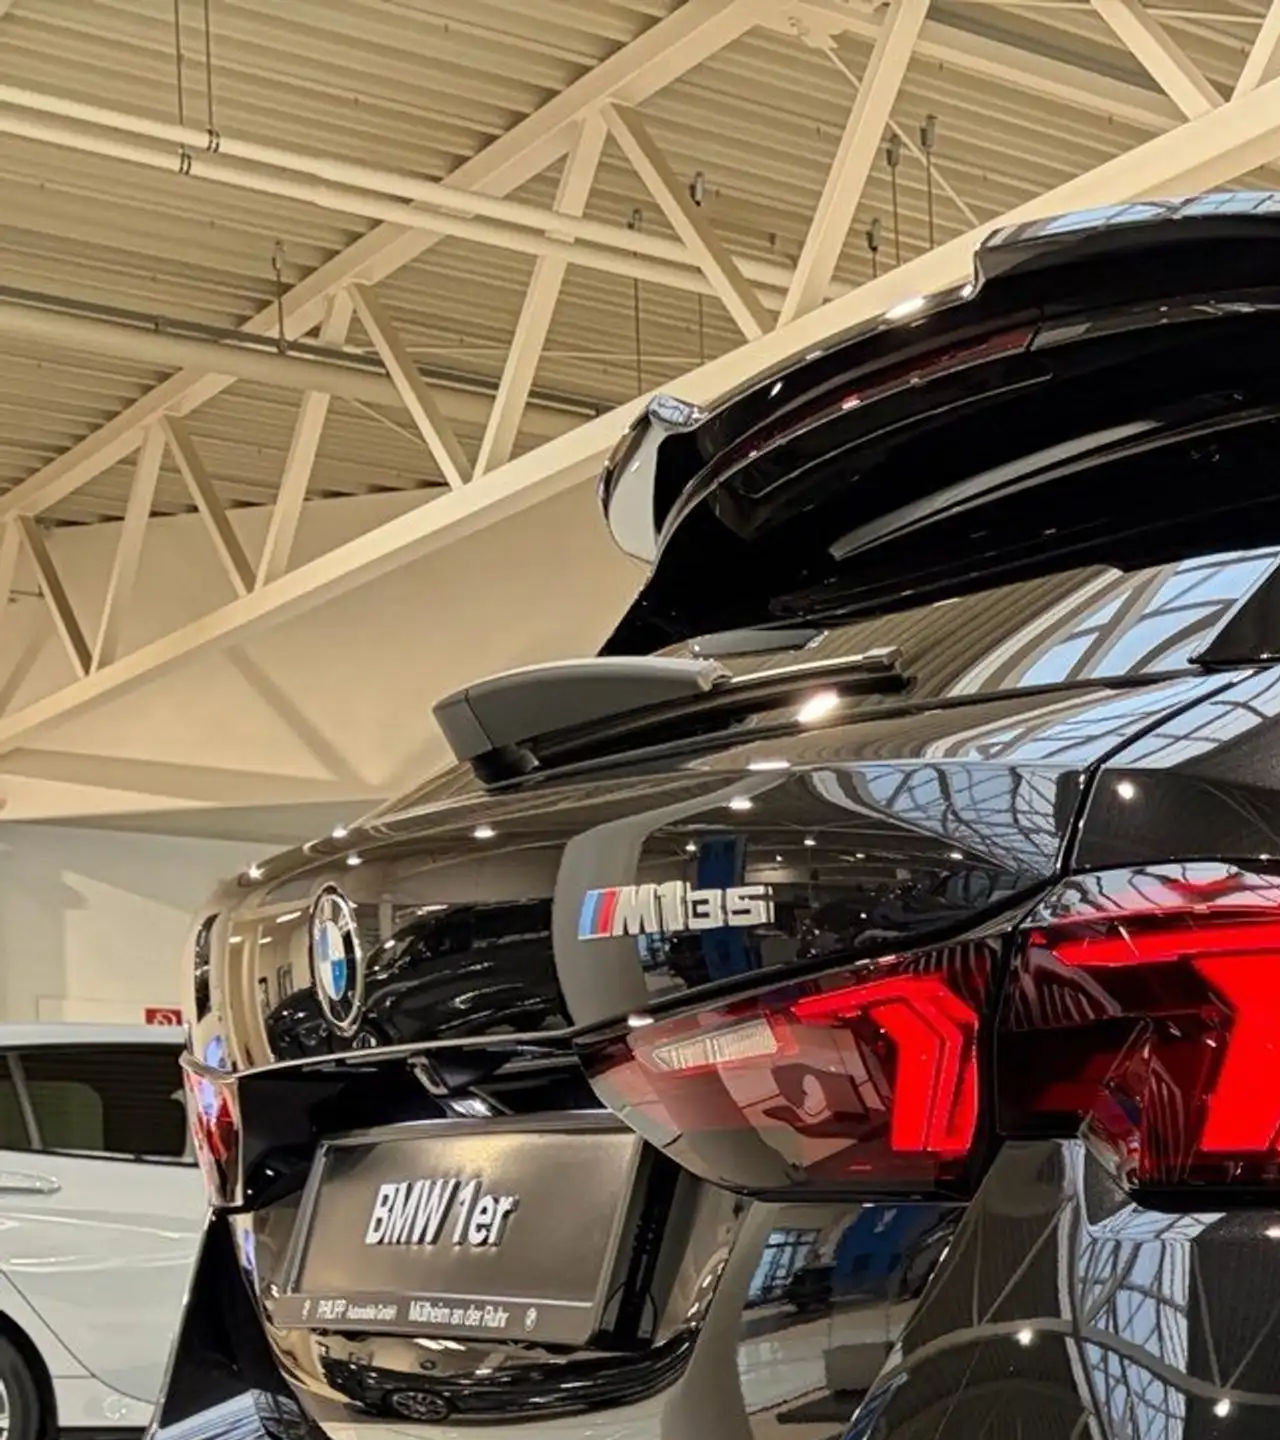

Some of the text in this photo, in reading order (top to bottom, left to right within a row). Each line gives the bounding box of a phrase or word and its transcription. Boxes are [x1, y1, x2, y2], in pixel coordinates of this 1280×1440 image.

[365, 1178, 518, 1246] BMW 1er
[408, 1300, 451, 1323] Mülheim
[451, 1308, 464, 1325] an
[464, 1304, 483, 1326] der
[482, 1305, 510, 1328] Ruhr
